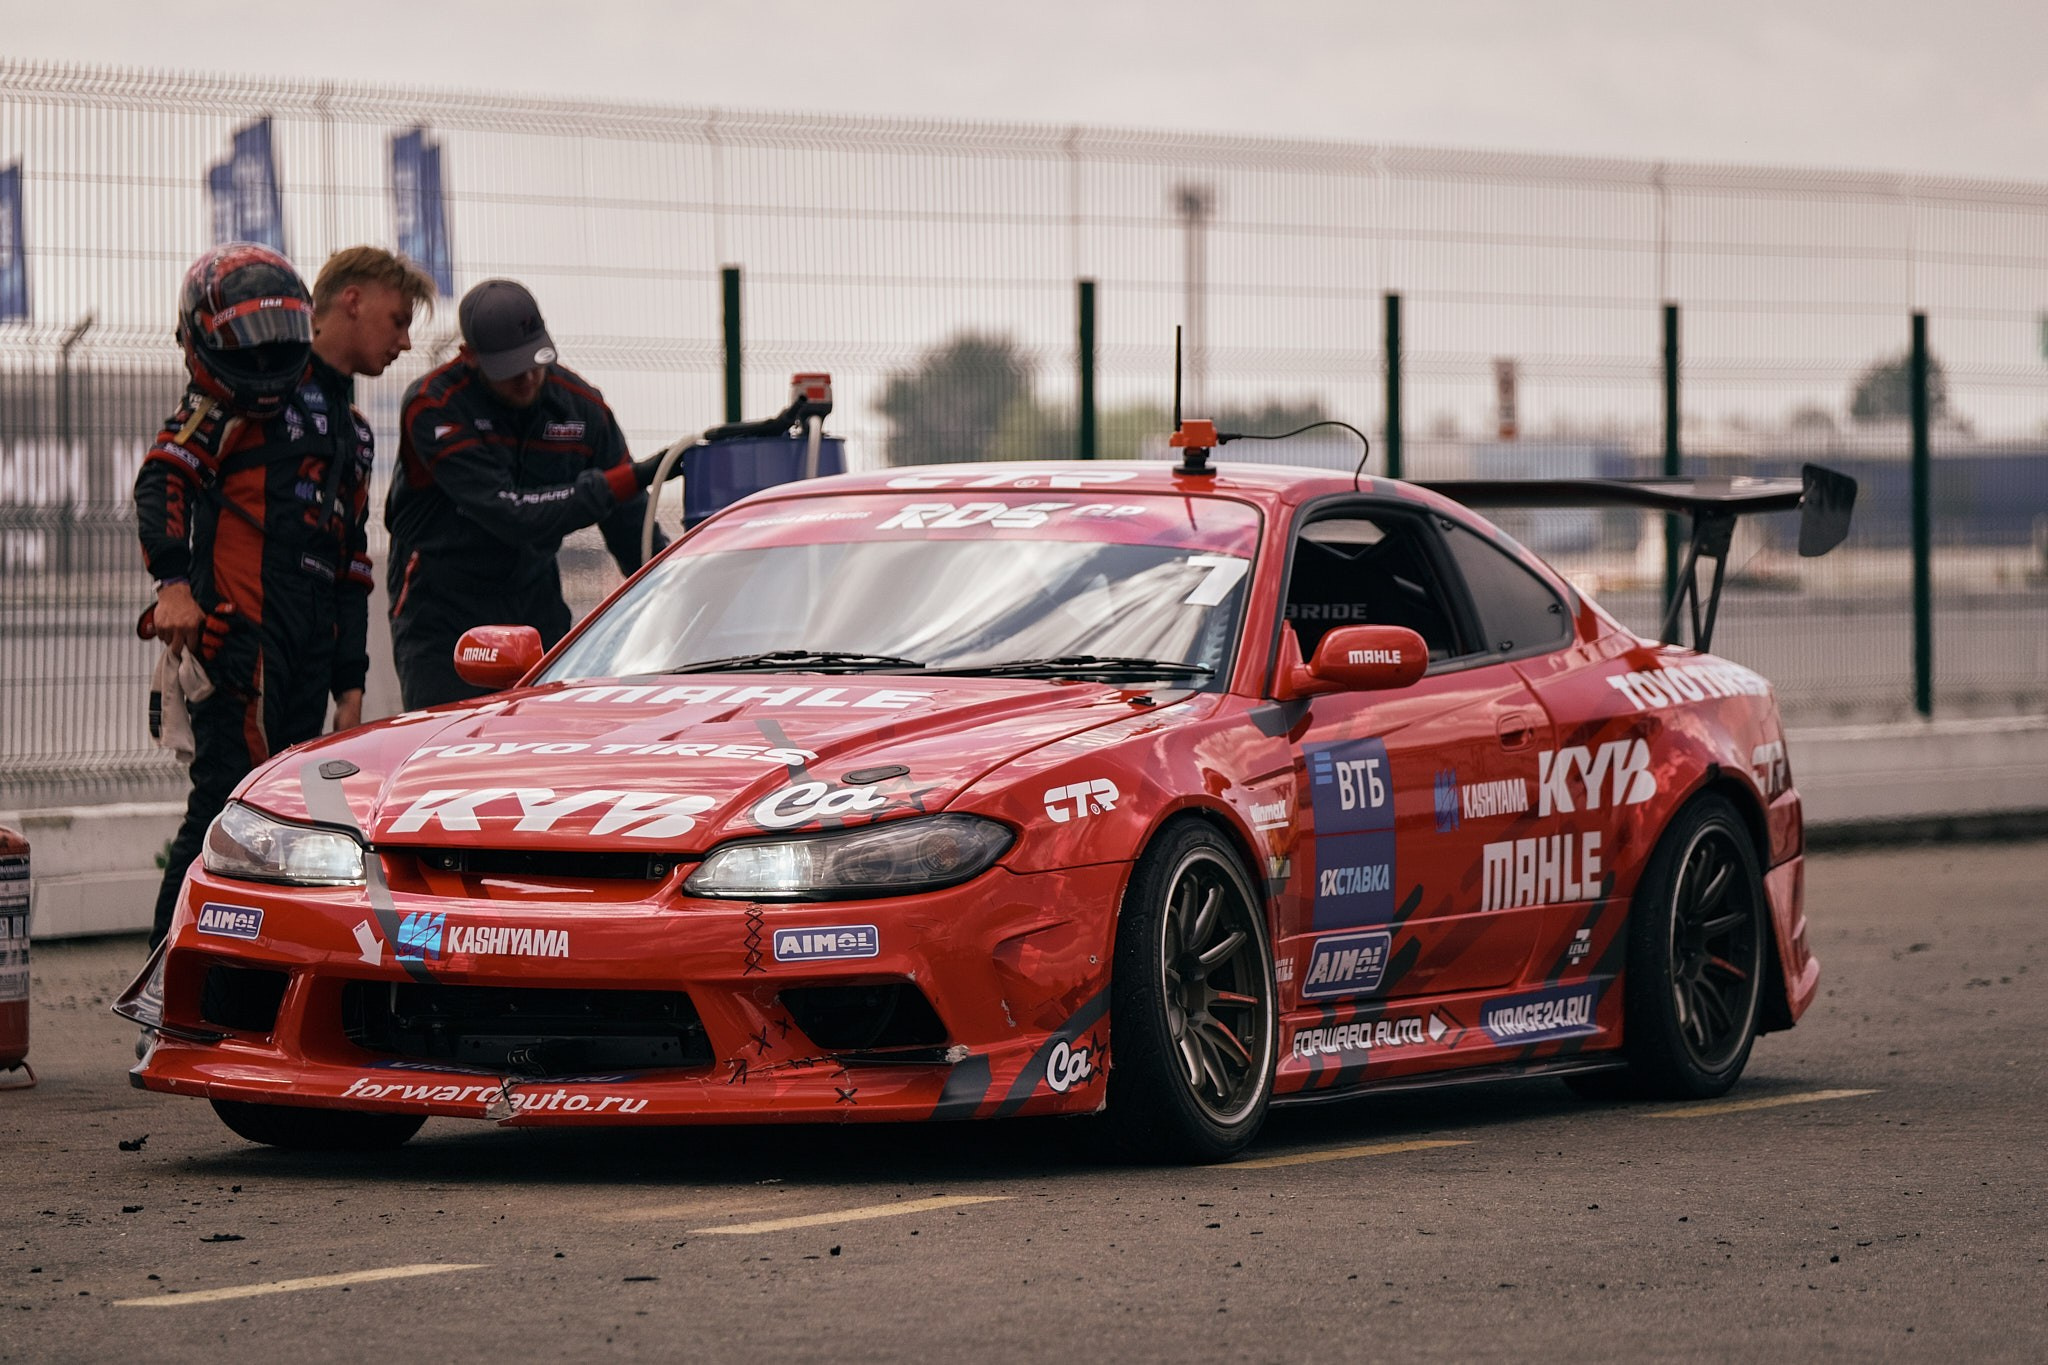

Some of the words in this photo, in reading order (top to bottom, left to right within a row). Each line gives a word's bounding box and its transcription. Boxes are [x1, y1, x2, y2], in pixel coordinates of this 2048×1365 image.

[875, 503, 1077, 529] RDS
[1070, 504, 1148, 519] GP
[1285, 603, 1367, 619] BRIDE
[462, 646, 499, 663] MAHLE
[1348, 650, 1401, 665] MAHLE
[539, 686, 936, 709] MAHLE
[1606, 667, 1705, 711] TOYO
[407, 742, 592, 761] TOYO
[594, 743, 820, 766] TIRES
[1336, 758, 1385, 811] ВТБ
[1538, 737, 1658, 818] KYB
[387, 788, 716, 838] KYB
[1044, 777, 1120, 823] CTR
[1462, 777, 1529, 819] KASHIYAMA
[1481, 831, 1602, 913] MAHLE
[201, 909, 258, 932] AIMOL
[447, 926, 569, 958] KASHIYAMA
[778, 932, 875, 956] AIMOL
[1308, 946, 1382, 985] AIMOL
[1487, 994, 1592, 1038] VIRAGE24.RU
[1293, 1021, 1372, 1059] FORWARD
[1375, 1018, 1425, 1046] AUTO
[1047, 1041, 1092, 1092] Ca
[341, 1077, 649, 1114] forwardauto.ru
